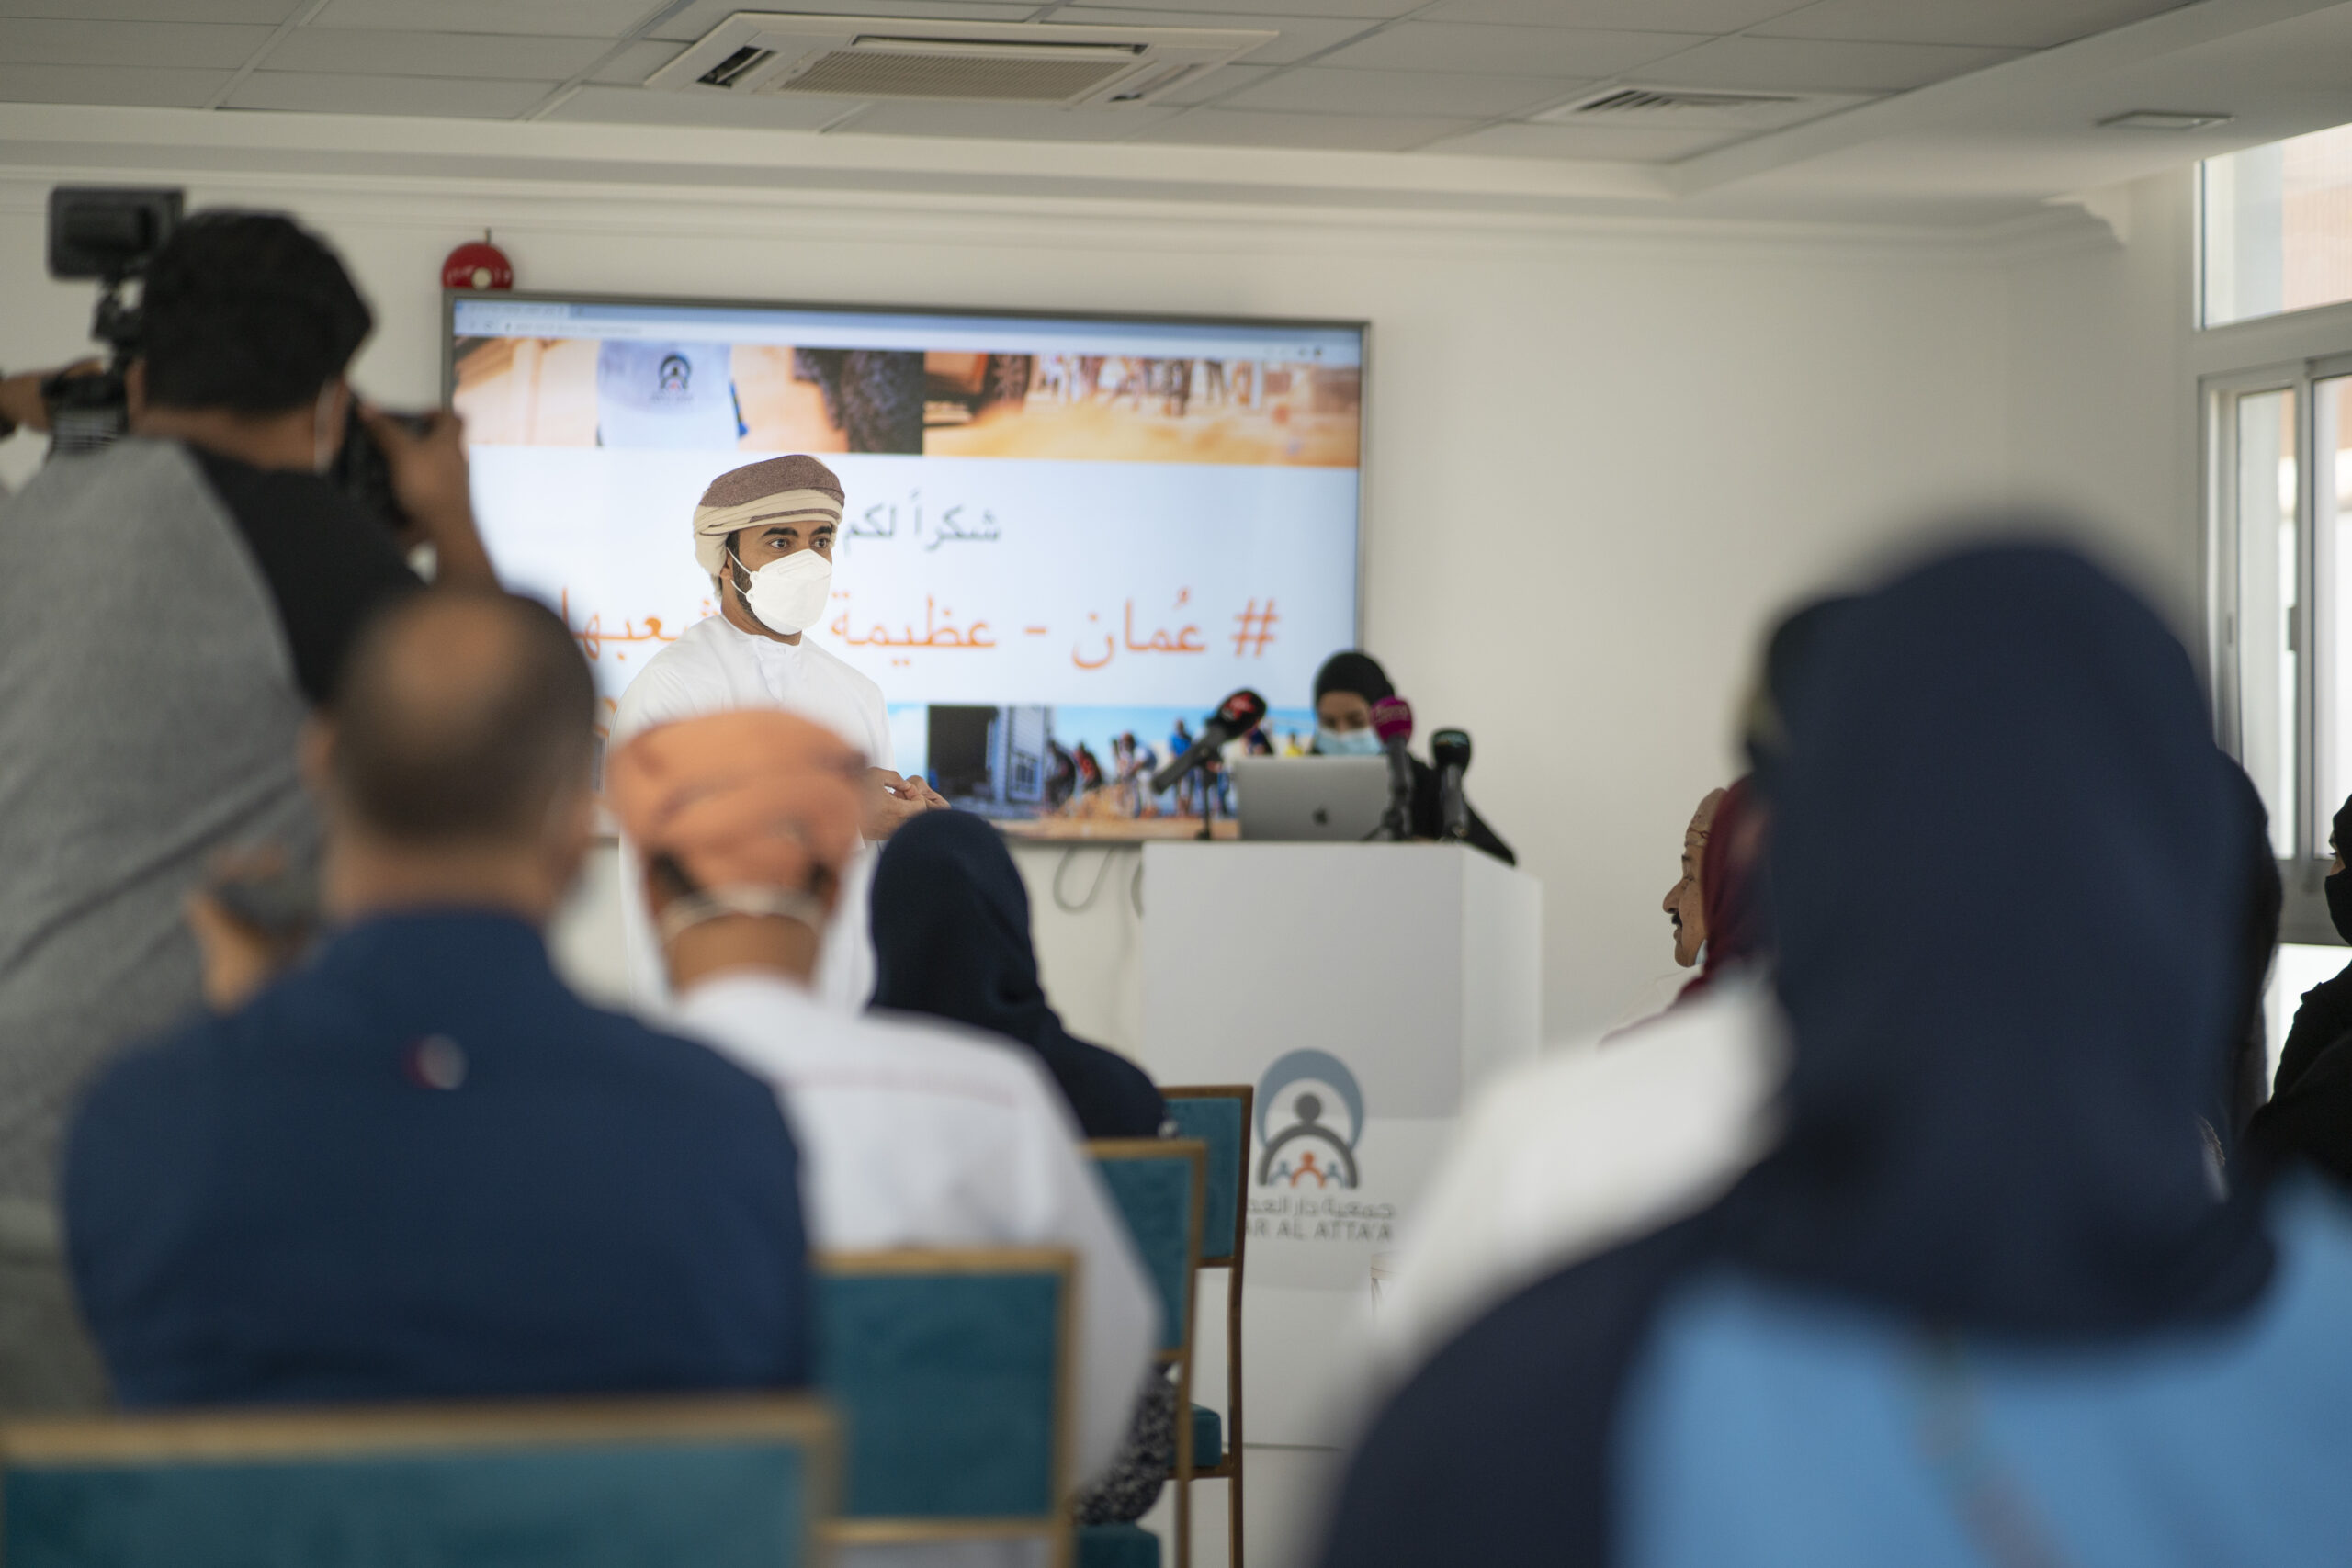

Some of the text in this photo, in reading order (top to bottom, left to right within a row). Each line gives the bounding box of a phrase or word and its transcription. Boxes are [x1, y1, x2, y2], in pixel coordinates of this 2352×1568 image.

[842, 502, 897, 557] لكم
[830, 591, 997, 667] عظيمة
[1276, 1218, 1306, 1240] AL
